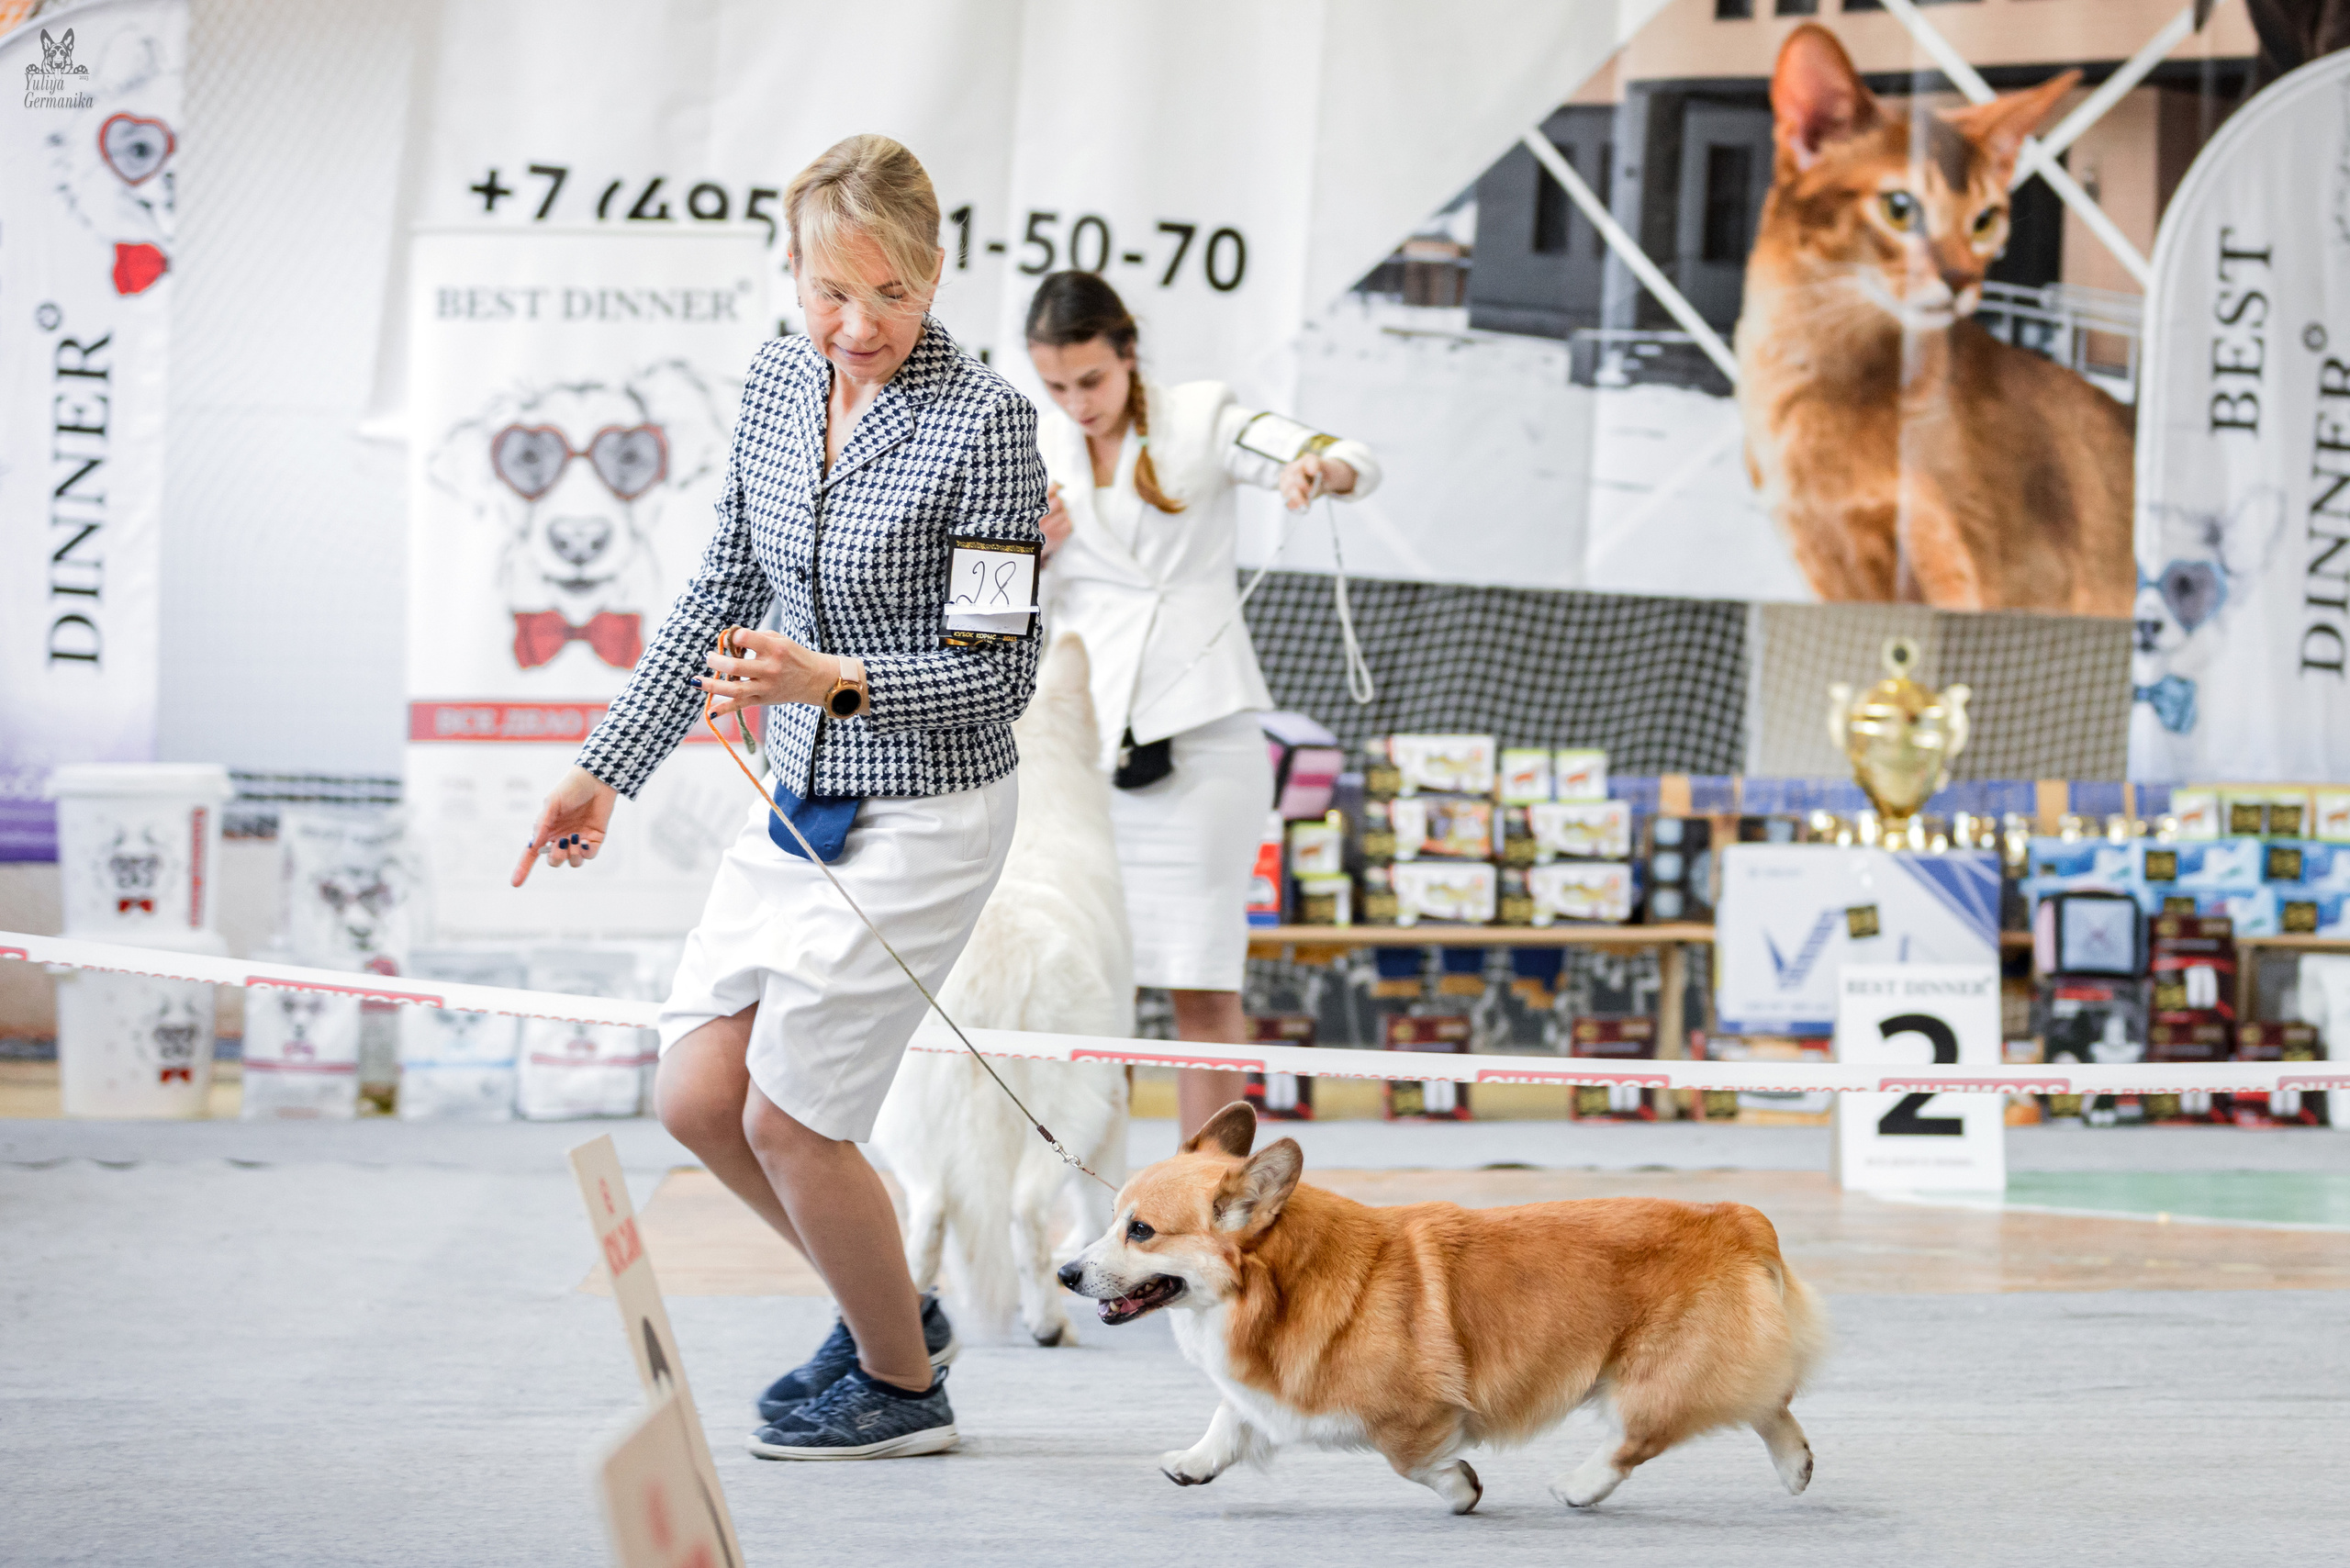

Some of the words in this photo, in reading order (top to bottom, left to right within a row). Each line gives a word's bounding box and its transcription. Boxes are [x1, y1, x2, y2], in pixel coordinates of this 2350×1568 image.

[471, 164, 569, 221] +7
[436, 286, 550, 321] BEST
[562, 286, 739, 321] DINNER
[2209, 226, 2273, 437] BEST
[49, 331, 112, 673] DINNER
[955, 560, 1017, 605] 28
[1877, 1014, 1964, 1136] 2
